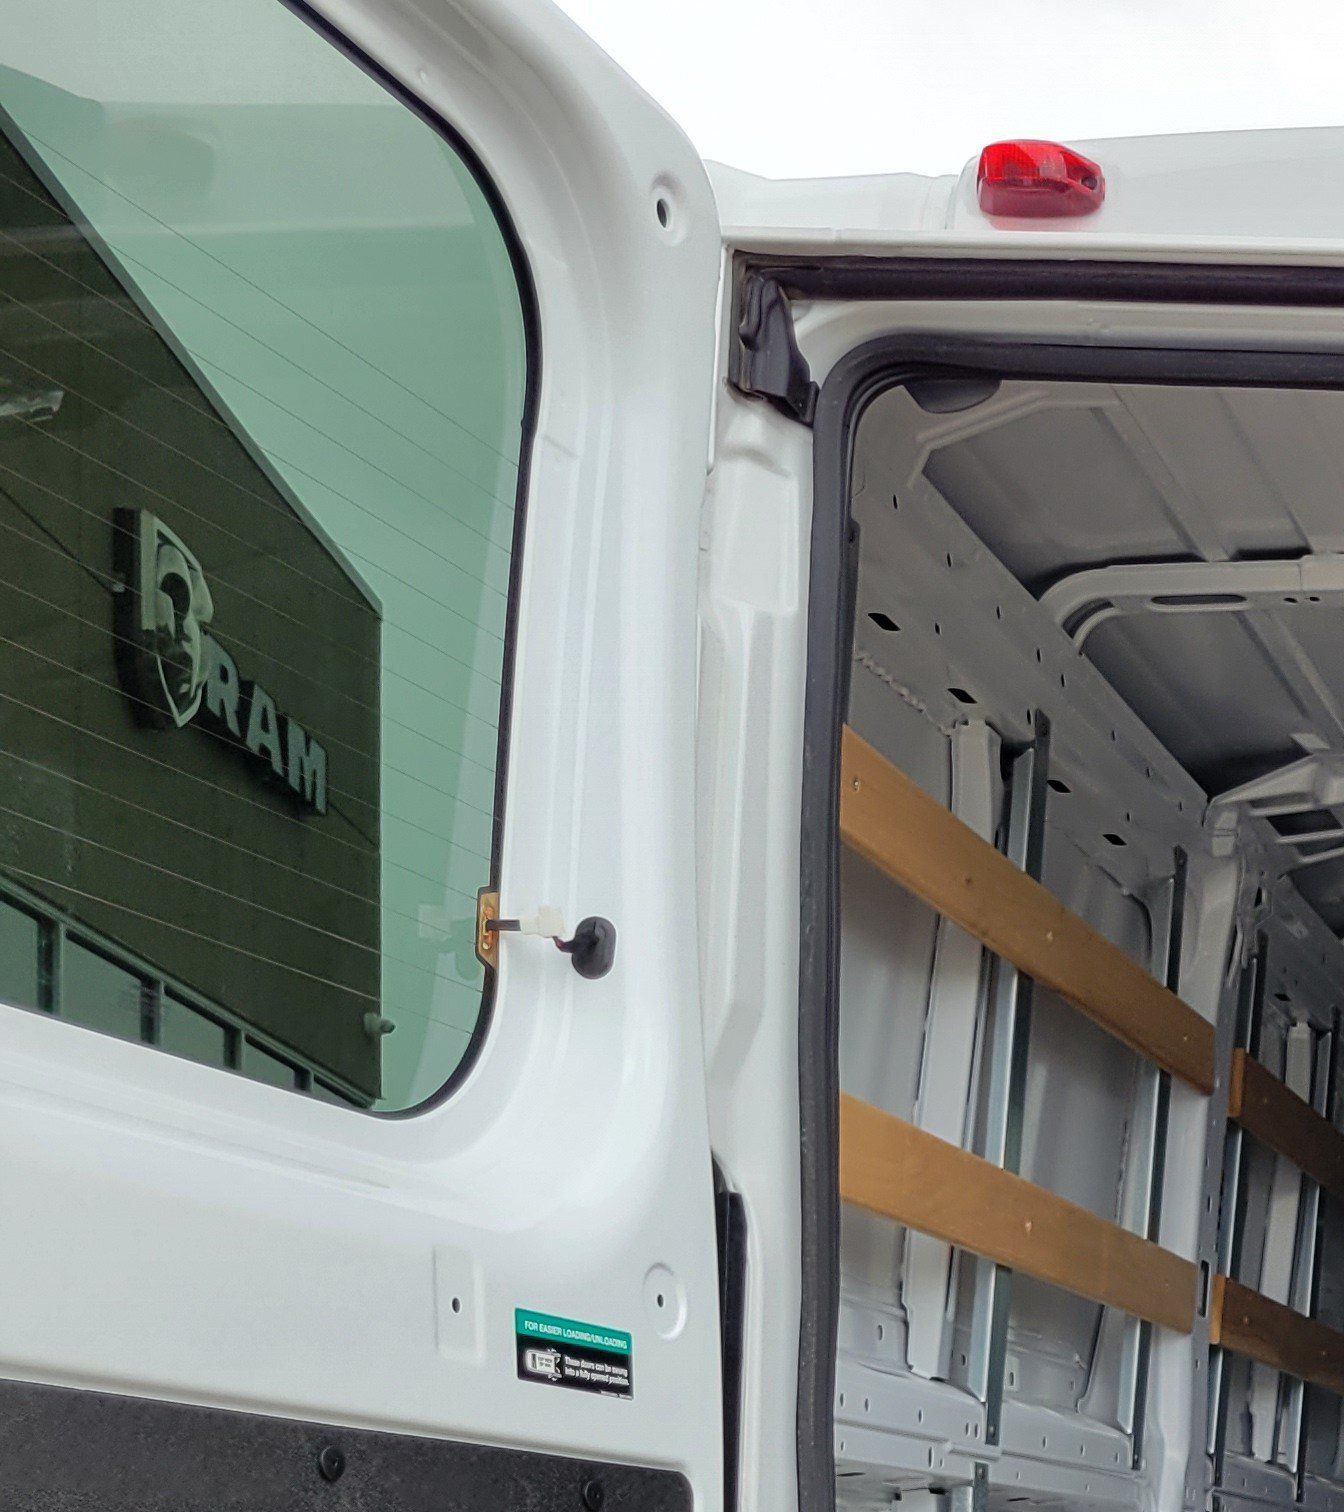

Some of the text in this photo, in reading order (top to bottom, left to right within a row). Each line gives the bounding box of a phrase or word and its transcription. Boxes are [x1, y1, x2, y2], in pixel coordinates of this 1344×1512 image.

[206, 631, 328, 815] RAM
[524, 1320, 538, 1332] FOR
[539, 1323, 562, 1337] EASIER
